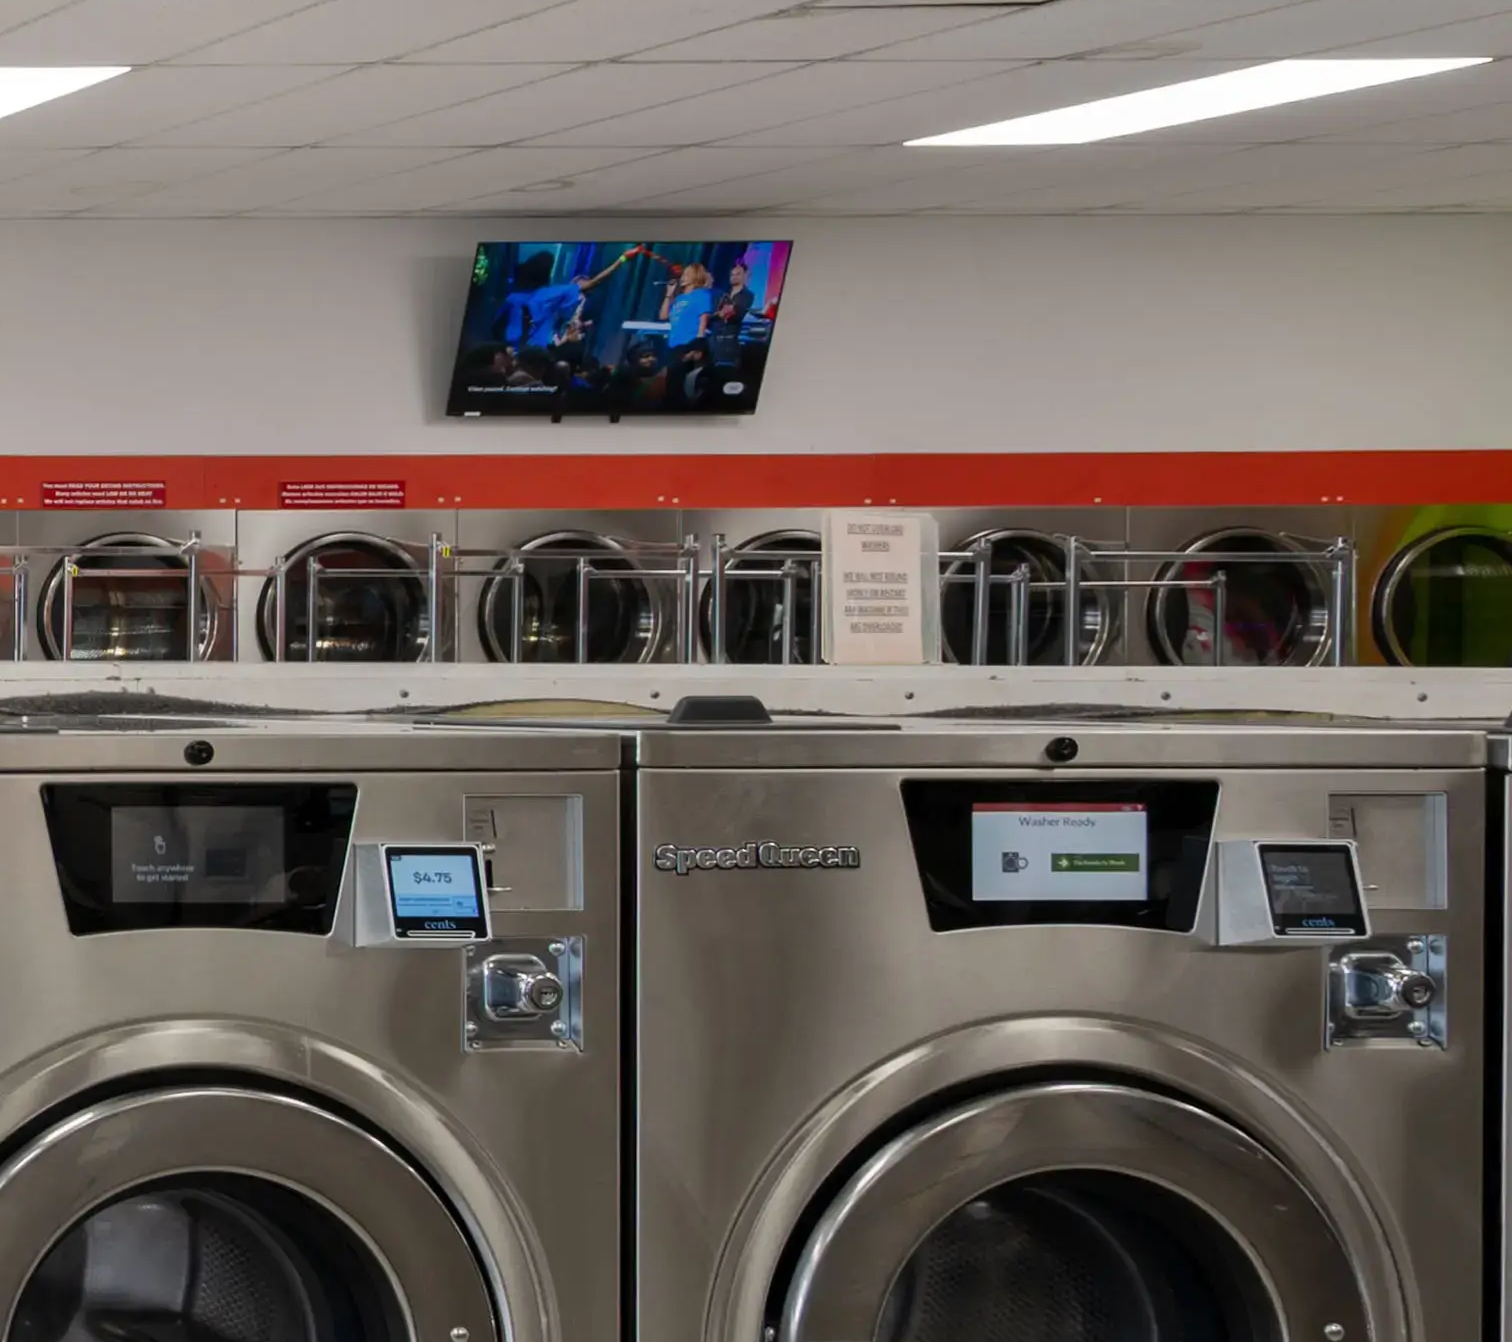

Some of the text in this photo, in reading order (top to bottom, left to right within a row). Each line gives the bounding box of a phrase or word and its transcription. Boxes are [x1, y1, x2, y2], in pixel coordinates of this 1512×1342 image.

[1018, 817, 1096, 827] Washer Ready
[655, 841, 860, 875] Speed Queen
[412, 871, 453, 885] $4.75
[424, 919, 456, 930] cents
